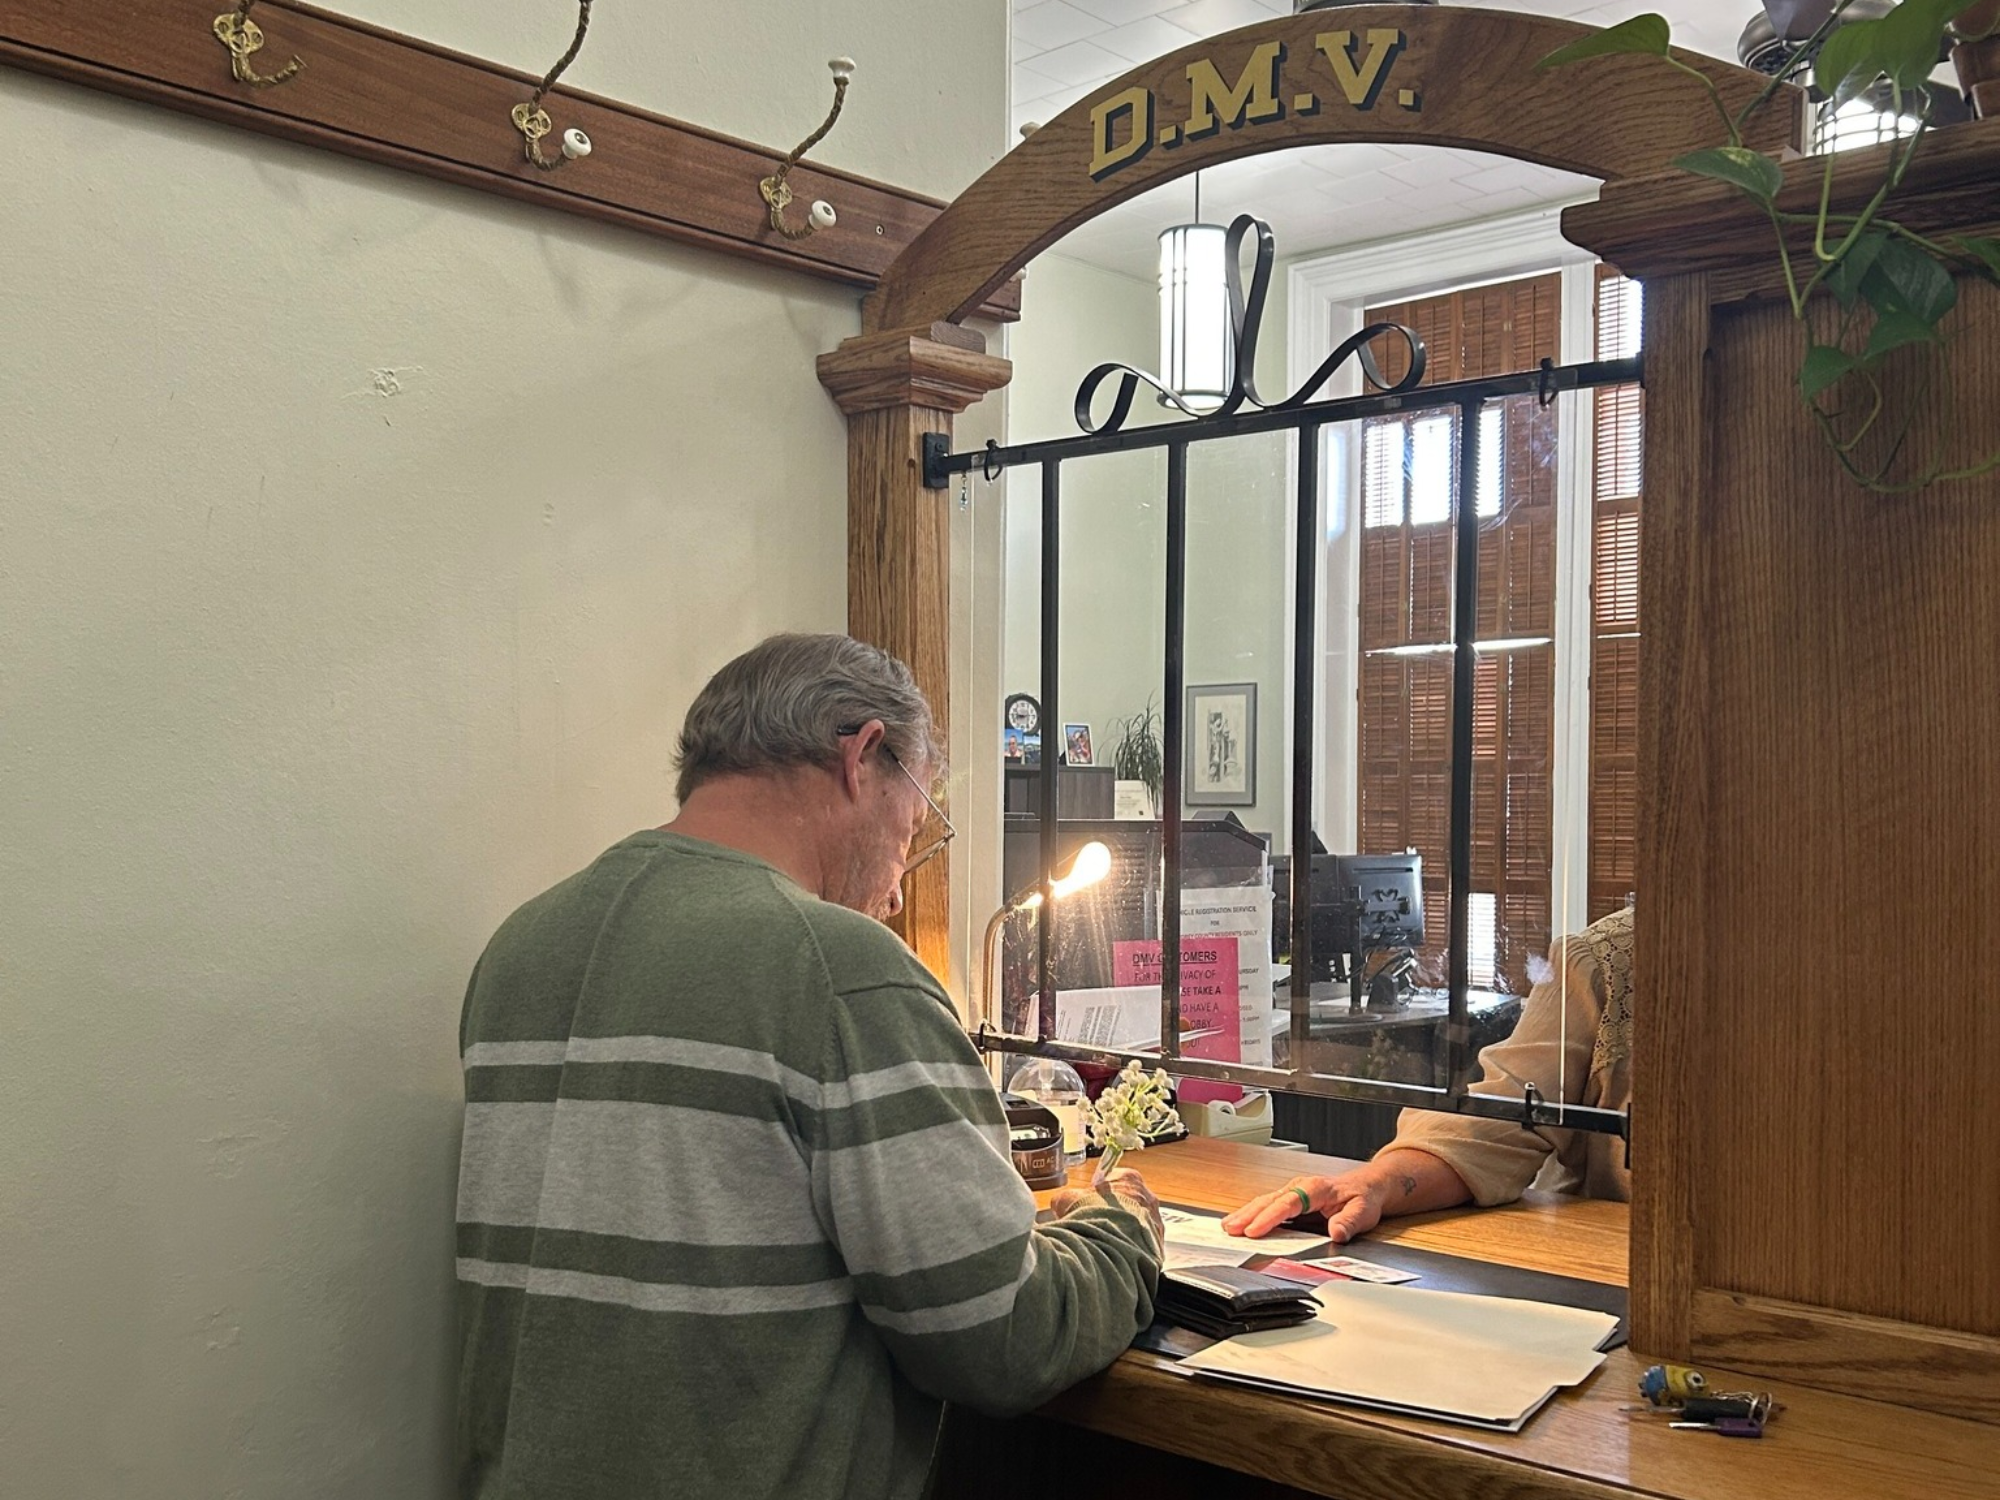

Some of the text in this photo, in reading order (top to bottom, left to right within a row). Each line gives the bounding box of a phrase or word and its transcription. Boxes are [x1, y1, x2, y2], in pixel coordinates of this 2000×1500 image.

[1089, 28, 1419, 181] D.M.V.
[1195, 907, 1232, 915] REGISTRATION
[1232, 905, 1256, 913] SERVICE
[1132, 953, 1155, 964] DMV
[1180, 970, 1203, 980] IVACY
[1204, 969, 1216, 979] OF
[1193, 986, 1213, 996] TAKE
[1215, 985, 1221, 995] A
[1190, 1002, 1211, 1012] HAVE
[1213, 1001, 1219, 1011] A
[1190, 1018, 1214, 1029] OBBY.
